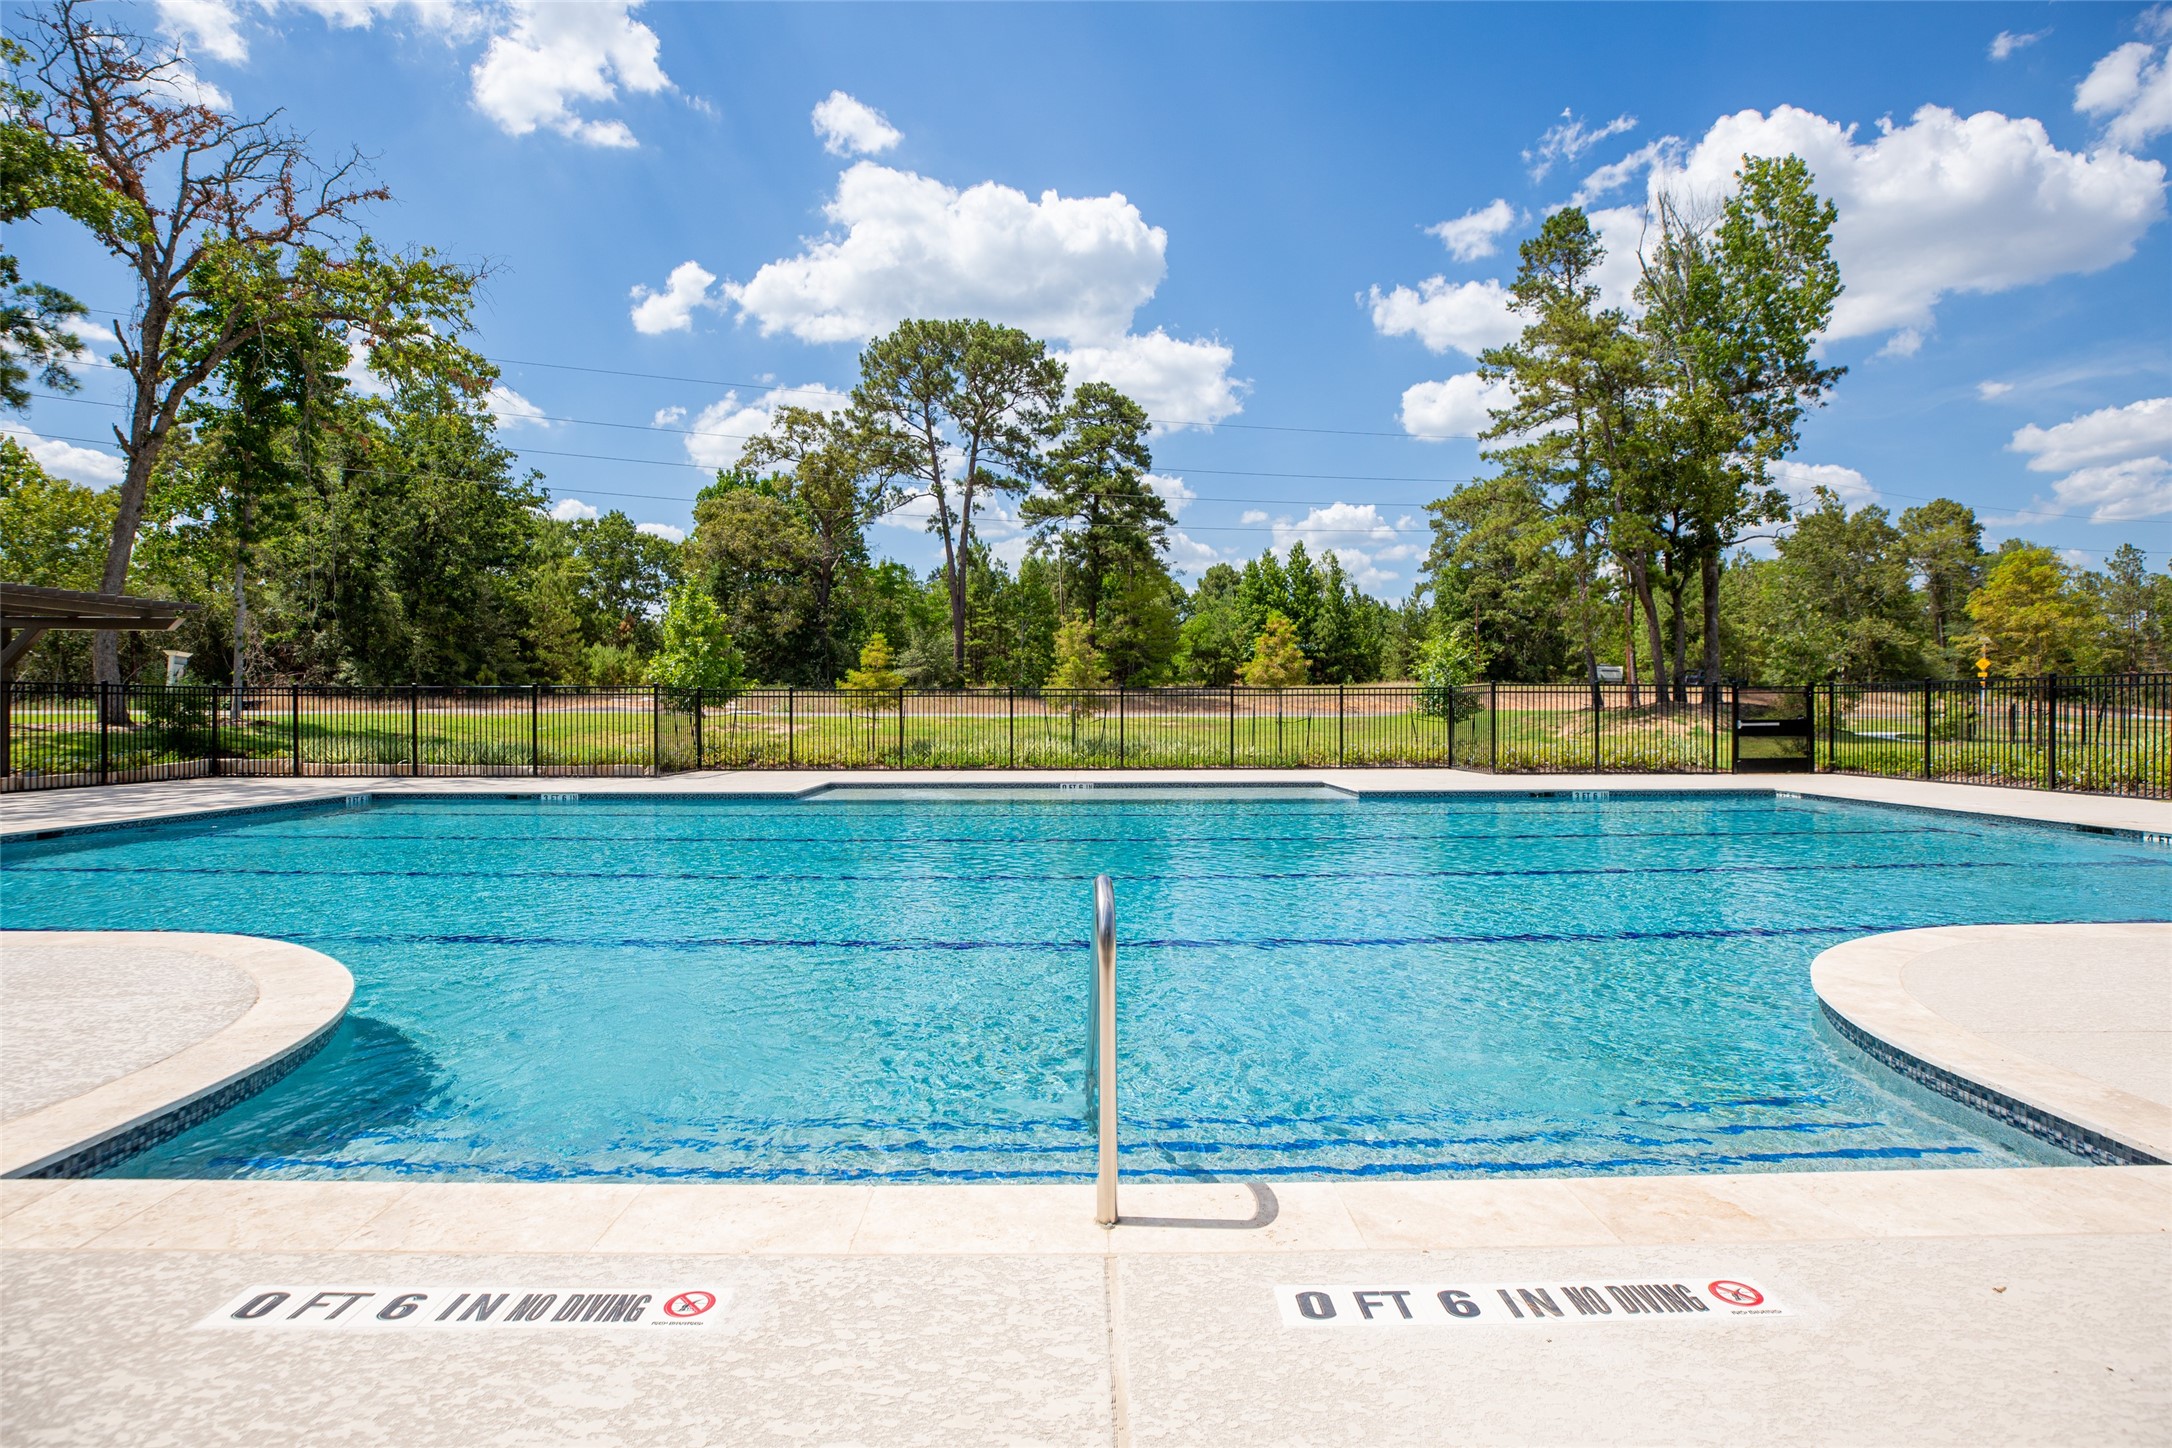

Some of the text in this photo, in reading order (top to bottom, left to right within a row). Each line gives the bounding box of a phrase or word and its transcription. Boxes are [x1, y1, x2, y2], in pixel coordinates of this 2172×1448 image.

[1582, 792, 1590, 800] FT
[1600, 792, 1608, 800] IN
[2158, 835, 2171, 844] FT
[231, 1292, 652, 1323] 0 FT 6 IN NO DIVING
[1295, 1283, 1710, 1320] 0 FT 6 IN NO DIVING
